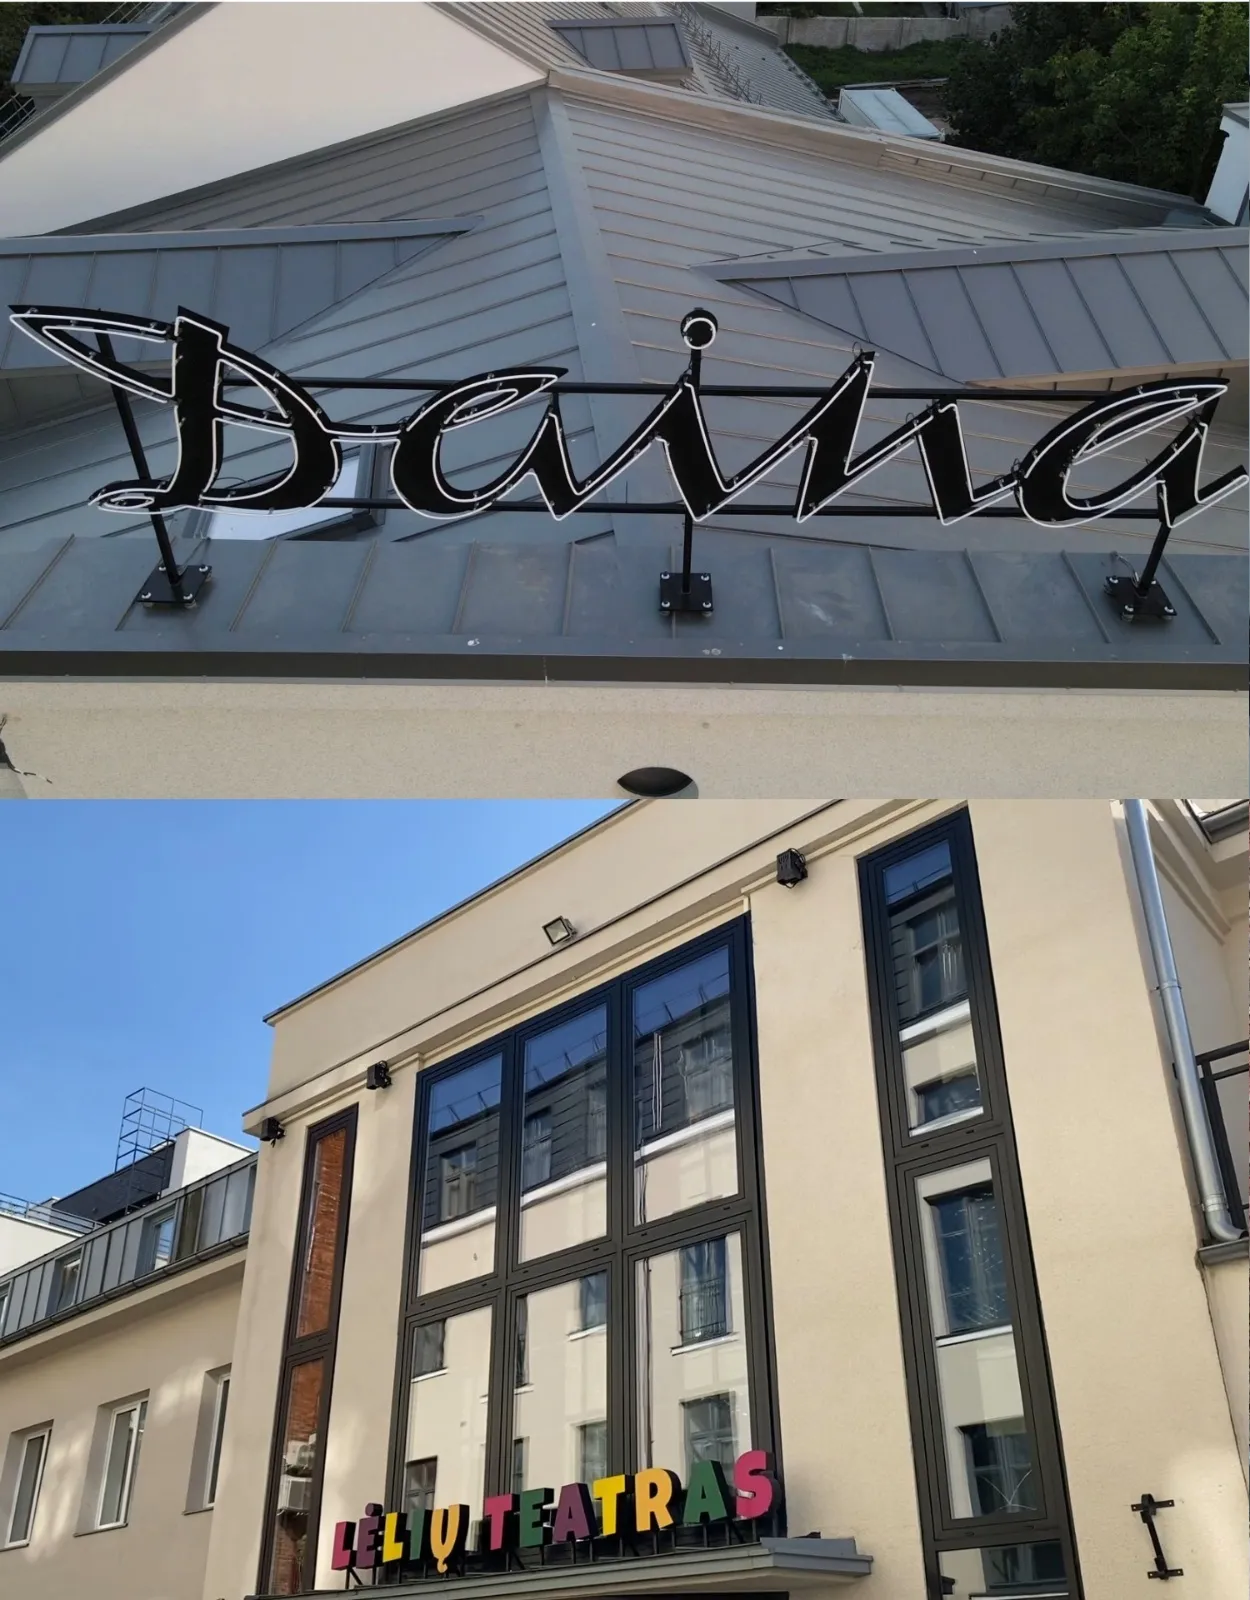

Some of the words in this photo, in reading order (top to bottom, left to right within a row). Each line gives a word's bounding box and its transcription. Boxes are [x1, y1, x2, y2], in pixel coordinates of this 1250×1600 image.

[8, 304, 1250, 528] Daina
[331, 1502, 471, 1573] LĖLIŲ
[484, 1450, 780, 1551] TEATRAS
